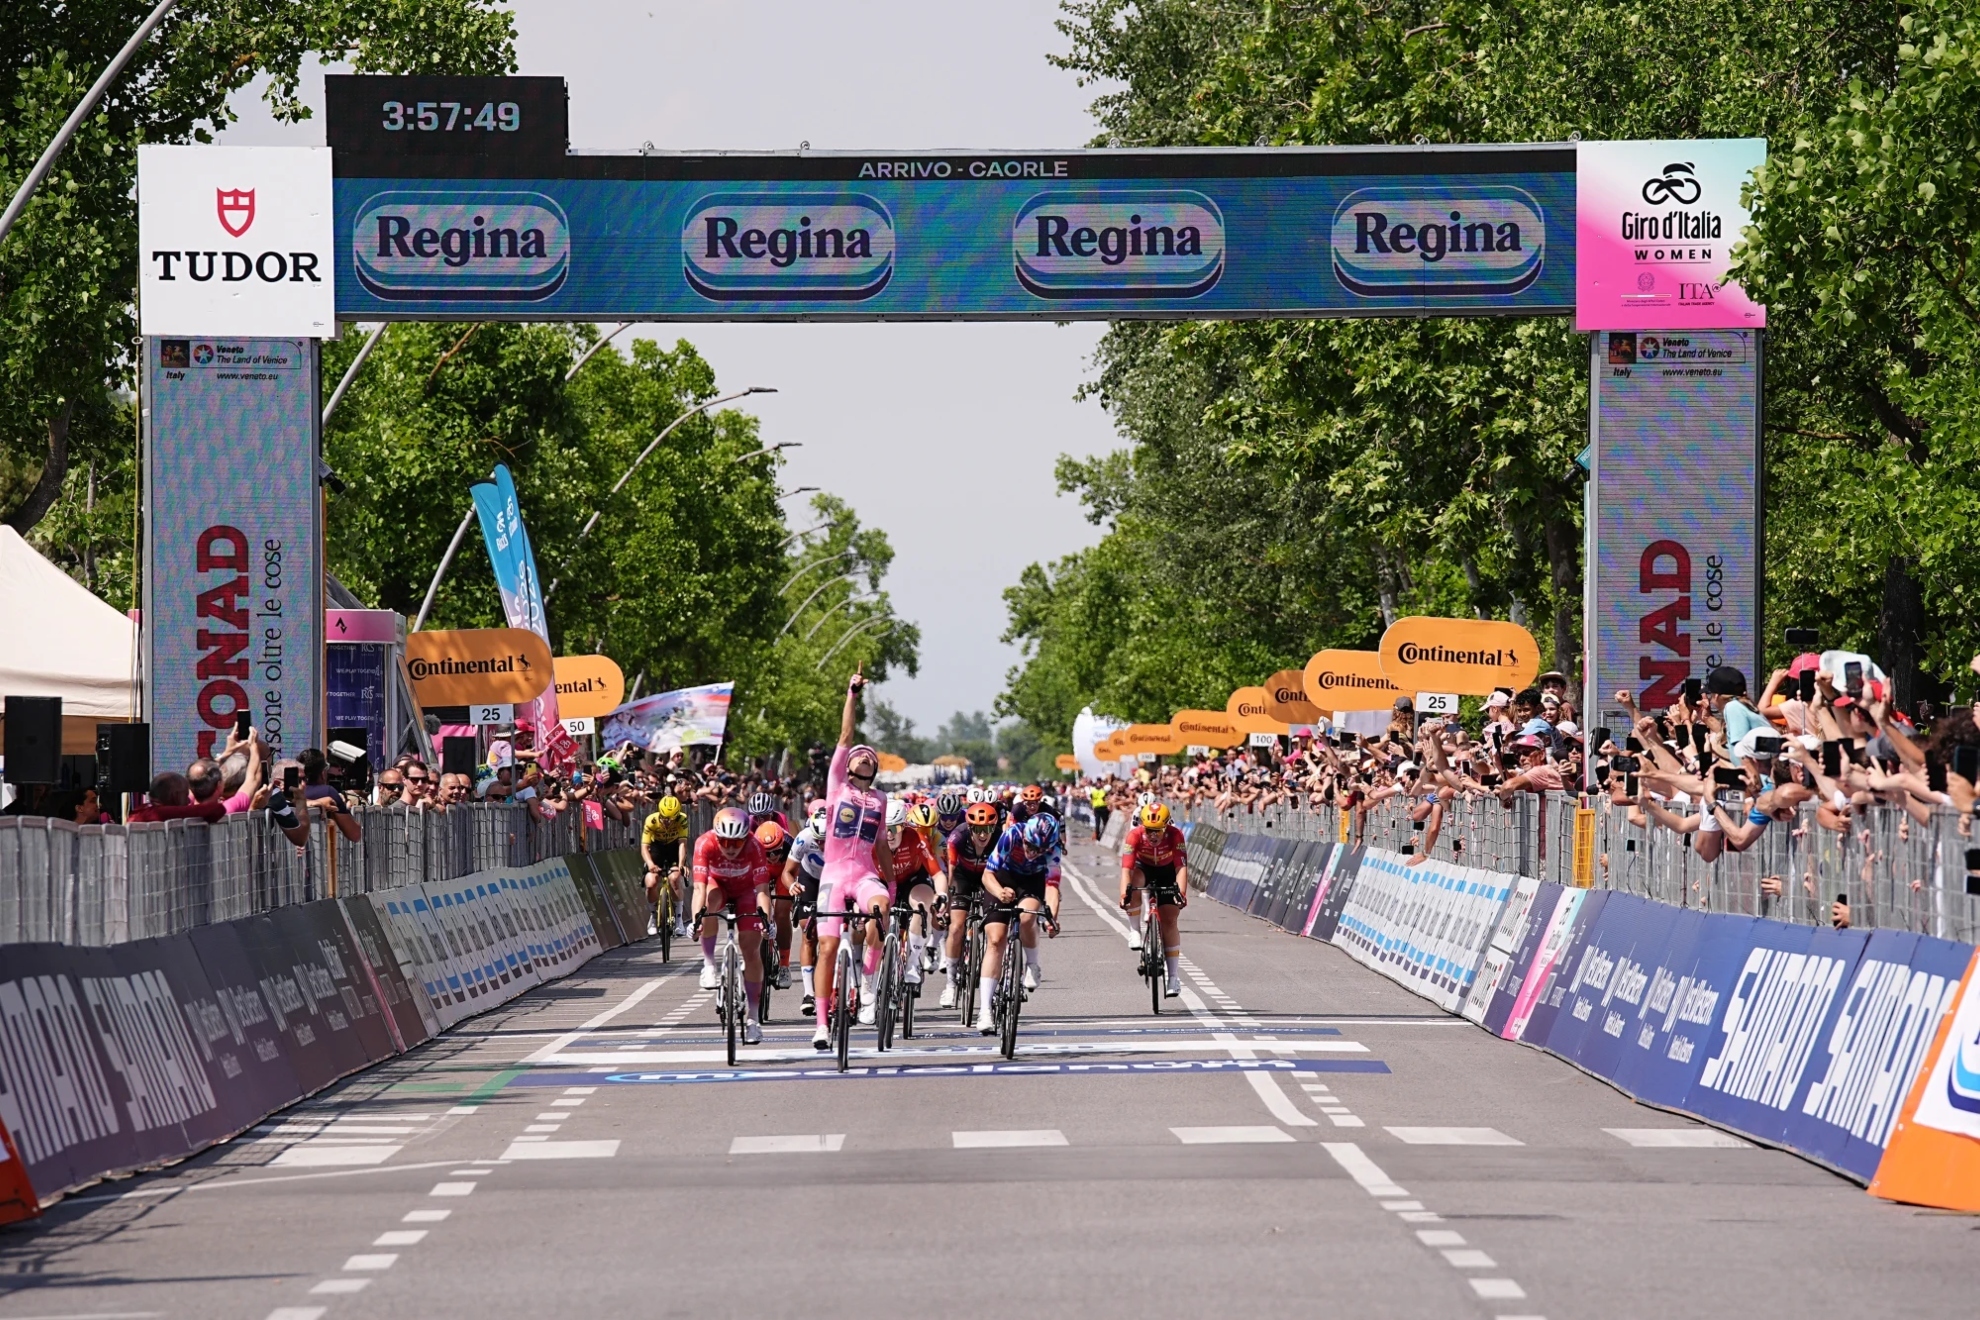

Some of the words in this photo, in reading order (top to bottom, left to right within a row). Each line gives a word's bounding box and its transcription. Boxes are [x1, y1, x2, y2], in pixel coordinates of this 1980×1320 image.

[383, 101, 520, 131] 3:57:49
[858, 161, 952, 178] ARRIVO
[969, 161, 1068, 178] CAORLE
[1621, 212, 1659, 241] Giro
[1662, 210, 1722, 240] d'Italia
[376, 216, 547, 267] Regina
[704, 216, 872, 268] Regina
[1036, 214, 1203, 264] Regina
[1354, 211, 1522, 262] Regina
[1634, 248, 1712, 261] WOMEN
[152, 251, 322, 283] TUDOR
[1678, 282, 1714, 300] ITA
[216, 345, 244, 354] Veneto
[1662, 337, 1689, 347] Veneto
[216, 355, 230, 364] The
[232, 355, 251, 364] Land
[252, 355, 261, 364] of
[262, 356, 288, 365] Venice
[1662, 349, 1676, 358] The
[1678, 349, 1697, 358] Land
[1698, 348, 1706, 358] of
[1707, 349, 1732, 358] Venice
[166, 371, 186, 381] Italy
[1613, 367, 1632, 378] Italy
[1662, 367, 1723, 377] www.veneto.eu
[264, 539, 282, 589] cose
[1705, 555, 1723, 611] cose
[256, 599, 282, 618] le
[1639, 539, 1691, 712] NAD
[1698, 622, 1723, 643] le
[257, 628, 282, 681] oltre
[1398, 641, 1502, 666] Continental
[407, 655, 514, 681] Continental
[1318, 671, 1400, 690] Continent
[1428, 696, 1447, 710] 25
[481, 708, 501, 721] 25
[570, 721, 585, 732] 50
[1255, 735, 1272, 744] 100
[1700, 947, 1846, 1111] SHIMANO
[82, 969, 217, 1132] SHIMANO
